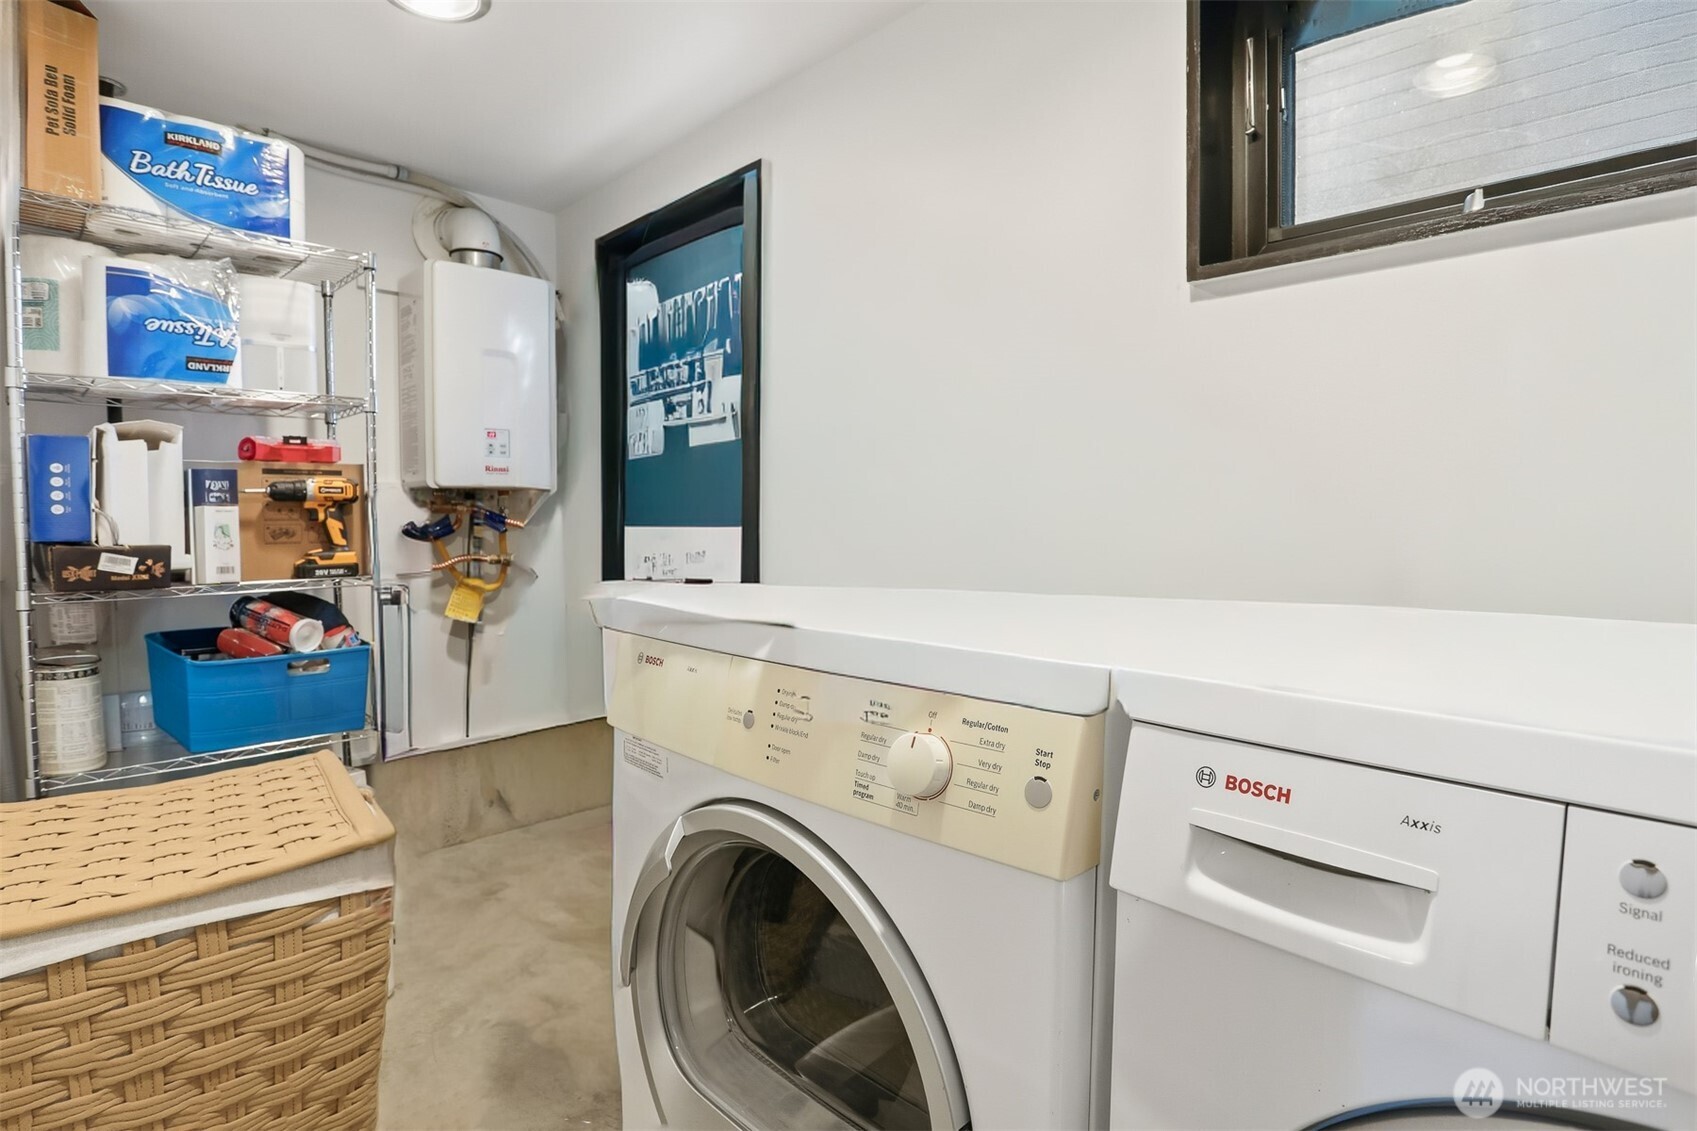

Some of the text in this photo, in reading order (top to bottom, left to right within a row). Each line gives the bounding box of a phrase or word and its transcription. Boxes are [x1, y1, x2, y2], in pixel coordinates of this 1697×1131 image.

[44, 89, 59, 115] Sofa
[45, 116, 60, 136] Pet
[62, 106, 76, 136] Solid
[167, 132, 221, 150] KIRKLAND
[130, 150, 260, 196] Bath Tissue
[144, 317, 215, 347] Tissue
[645, 654, 664, 667] BOSCH
[928, 710, 938, 721] Off
[961, 717, 1009, 734] Regular/Cotton
[860, 731, 887, 745] Regular dry
[979, 737, 1006, 751] Extra dry
[857, 750, 880, 763] Damp dry
[1035, 747, 1054, 759] Start
[978, 758, 1003, 772] Very dry
[1034, 758, 1051, 770] Stop
[855, 768, 876, 781] Touch up
[854, 780, 870, 791] Timed
[966, 778, 1000, 795] Regular dry
[1224, 774, 1292, 804] BOSCH
[852, 789, 874, 800] program
[896, 792, 912, 802] Warm
[895, 801, 903, 809] 40
[968, 800, 997, 816] Damp dry
[1400, 814, 1442, 835] Axxis
[1618, 901, 1663, 922] Signal
[1606, 942, 1671, 971] Reduced
[1612, 960, 1663, 989] ironing
